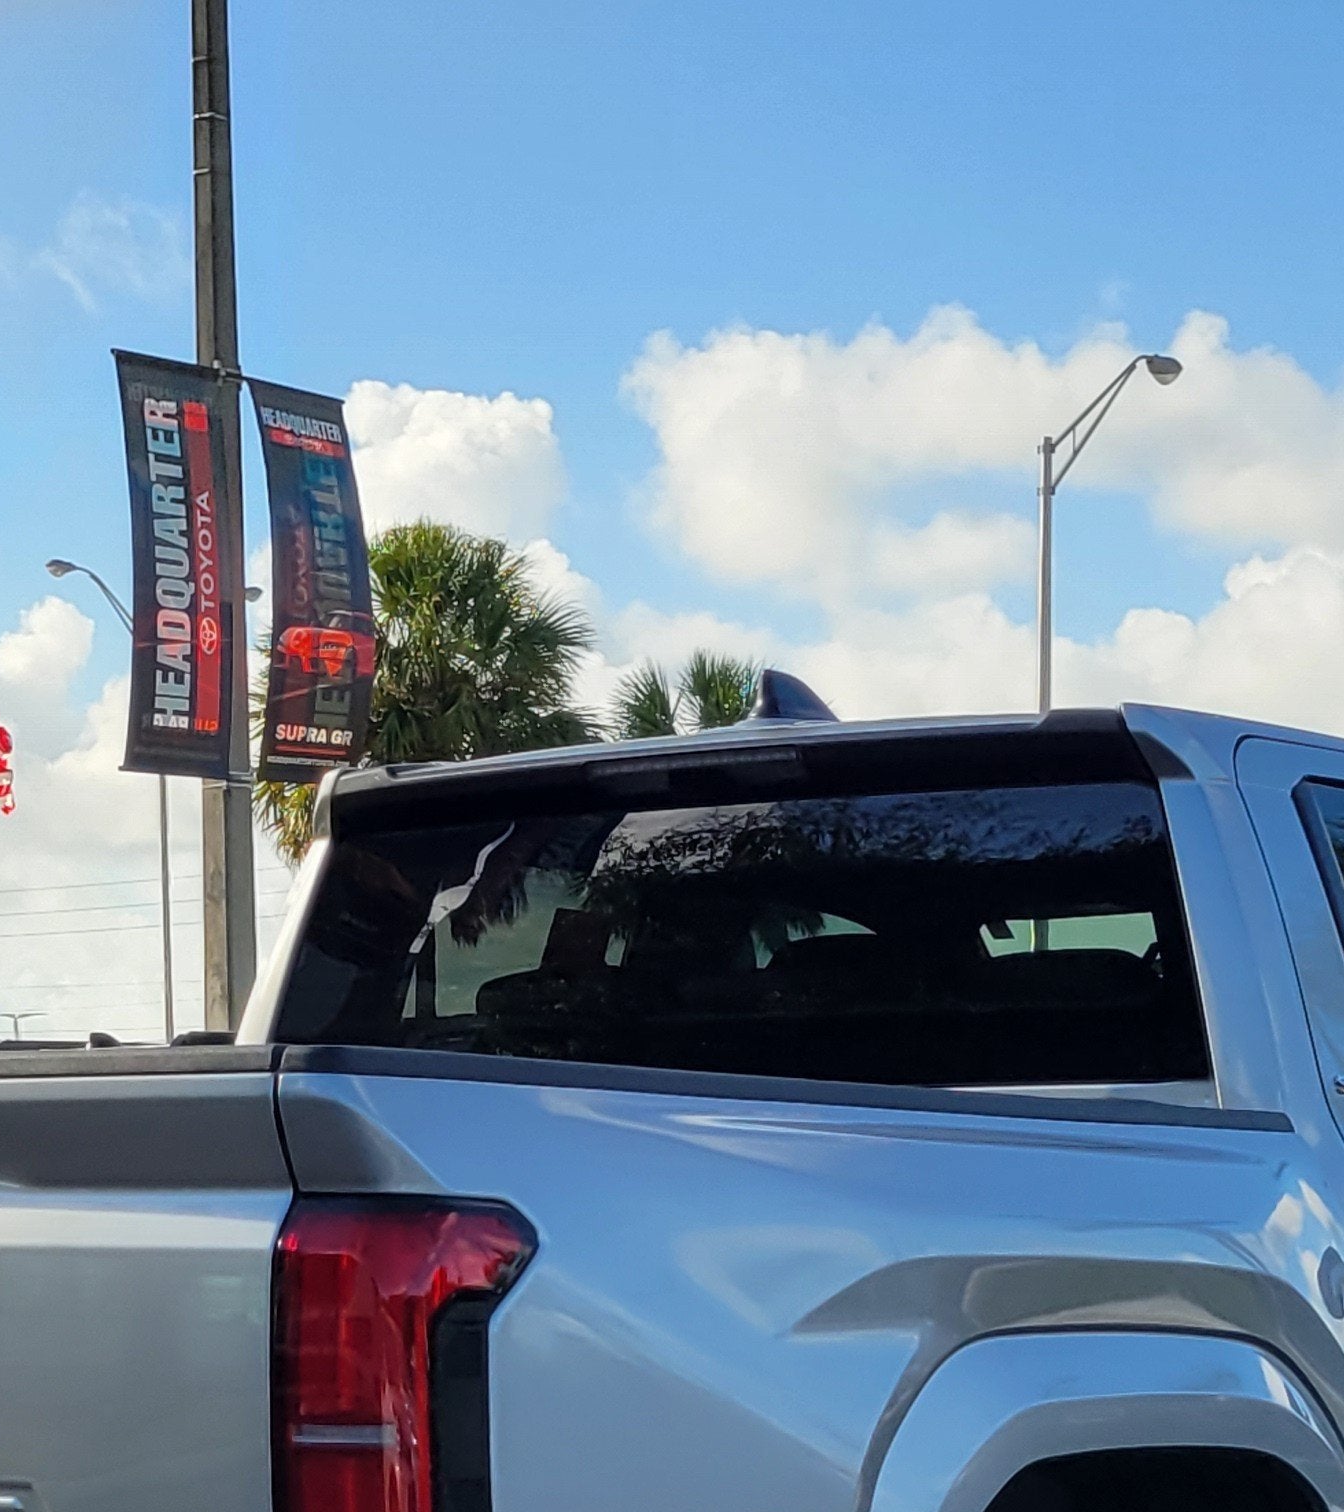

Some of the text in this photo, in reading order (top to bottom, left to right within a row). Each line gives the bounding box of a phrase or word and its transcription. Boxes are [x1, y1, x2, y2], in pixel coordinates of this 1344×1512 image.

[260, 405, 343, 444] HEADQUARTER
[144, 398, 195, 729] HEADQUARTER
[197, 491, 215, 612] TOYOTA
[275, 723, 353, 746] SUPRA GR
